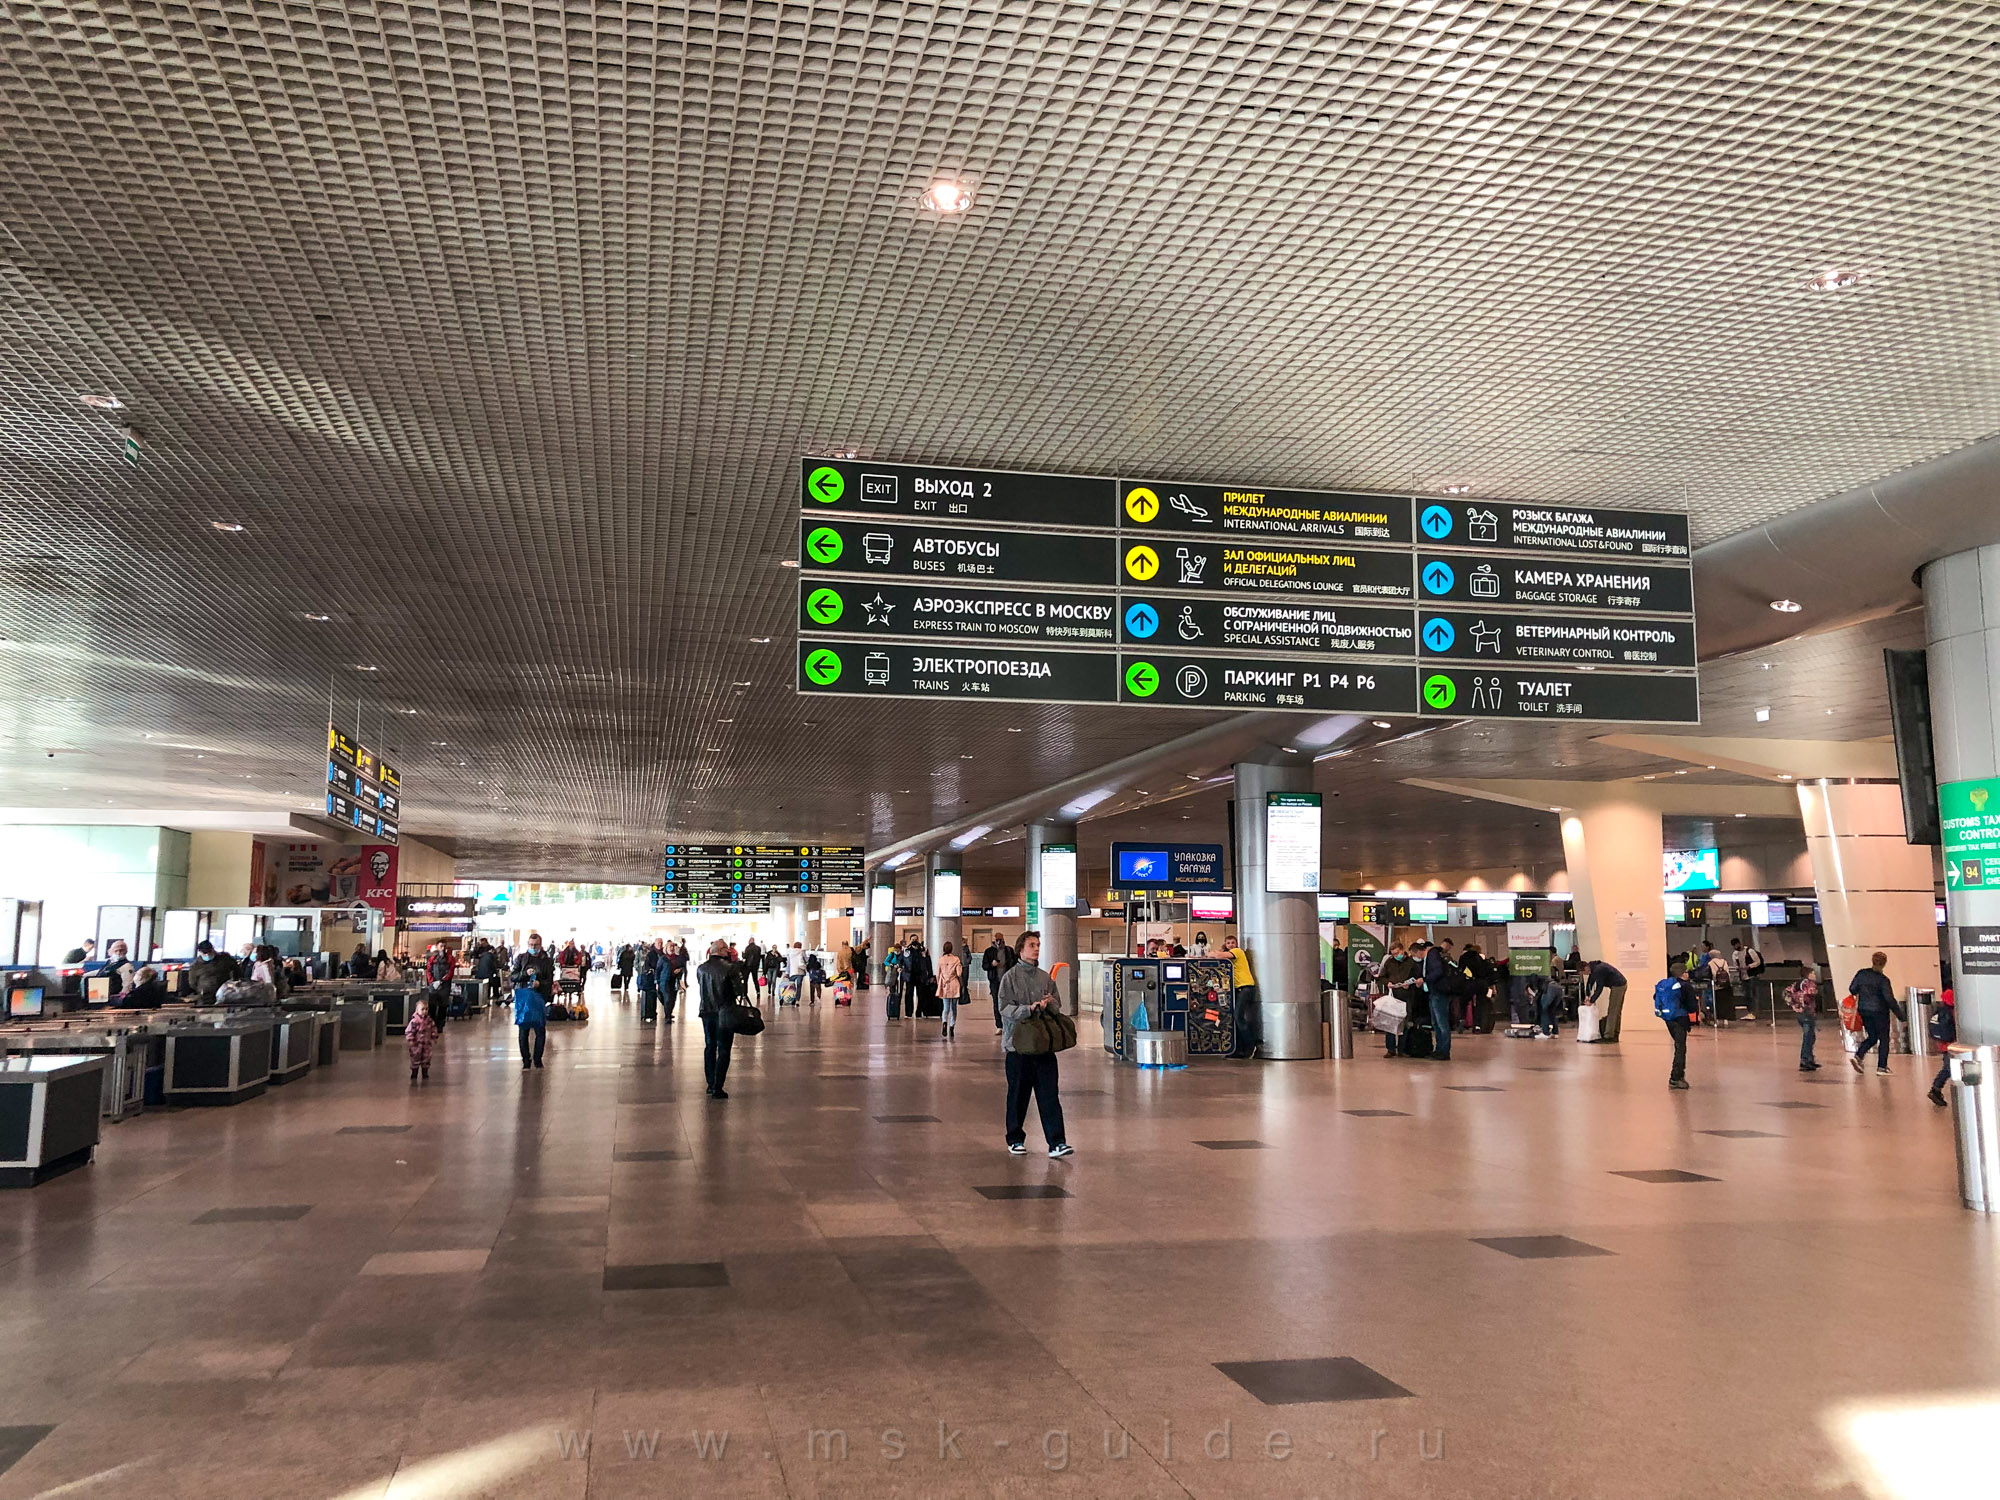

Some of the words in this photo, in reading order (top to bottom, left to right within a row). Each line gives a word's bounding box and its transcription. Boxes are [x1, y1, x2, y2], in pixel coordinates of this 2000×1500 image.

[867, 483, 891, 493] EXIT
[915, 478, 974, 498] ВЫХОД
[983, 483, 991, 497] 2
[1224, 492, 1265, 506] ПРИЛЕТ
[915, 501, 937, 510] EXIT
[949, 503, 967, 513] 出口
[1224, 505, 1320, 522] МЕЖДУНАРОДНЫЕ
[1322, 511, 1387, 525] АВИАЛИНИИ
[1513, 509, 1553, 523] РОЗЫСК
[1555, 512, 1594, 524] БАГАЖА
[1224, 519, 1299, 531] INTERNATIONAL
[1300, 523, 1344, 534] ARRIVALS
[1355, 526, 1390, 537] 国际到达
[1513, 522, 1603, 538] МЕЖДУНАРОДНЫЕ
[1606, 528, 1665, 540] АВИАЛИНИИ
[913, 538, 999, 557] АВТОБУСЫ
[1514, 535, 1577, 547] INTERNATIONAL
[1579, 538, 1633, 550] LOST&FOUND
[1224, 550, 1244, 560] ЗАЛ
[1247, 551, 1330, 567] ОФИЦИАЛЬНЫХ
[1332, 556, 1355, 567] ЛИЦ
[914, 560, 945, 571] BUSES
[957, 563, 994, 573] 机场巴士
[1224, 564, 1232, 574] И
[1234, 561, 1296, 576] ДЕЛЕГАЦИЙ
[1224, 578, 1258, 587] OFFICIAL
[1260, 579, 1311, 589] DELEGATIONS
[1313, 582, 1343, 591] LOUNGE
[1515, 570, 1573, 586] КАМЕРА
[1576, 574, 1650, 590] ХРАНЕНИЯ
[1516, 591, 1555, 601] BAGGAGE
[1559, 593, 1597, 603] STORAGE
[914, 598, 1031, 616] АЭРОЭКСПРЕСС
[1036, 604, 1045, 617] В
[1050, 604, 1112, 620] МОСКВУ
[1224, 607, 1311, 621] ОБСЛУЖИВАНИЕ
[1312, 611, 1336, 624] ЛИЦ
[914, 620, 953, 630] EXPRESS
[955, 622, 981, 631] TRAIN
[985, 623, 996, 632] TO
[999, 624, 1039, 634] MOSCOW
[1224, 620, 1231, 630] С
[1233, 618, 1320, 636] ОГРАНИЧЕННОЙ
[1322, 625, 1412, 640] ПОДВИЖНОСТЬЮ
[1224, 634, 1262, 644] SPECIAL
[1264, 636, 1320, 646] ASSISTANCE
[1516, 626, 1610, 640] ВЕТЕРИНАРНЫЙ
[1613, 629, 1675, 643] КОНТРОЛЬ
[1516, 647, 1570, 656] VETERINARY
[1573, 649, 1614, 658] CONTROL
[913, 658, 1051, 678] ЭЛЕКТРОПОЕЗДА
[913, 680, 949, 690] TRAINS
[962, 682, 989, 692] 火车站
[1225, 670, 1295, 686] ПАРКИНГ
[1304, 673, 1321, 687] P1
[1330, 674, 1349, 688] P4
[1357, 675, 1375, 689] P6
[1517, 682, 1572, 696] ТУАЛЕТ
[1225, 692, 1265, 702] PARKING
[1277, 695, 1303, 704] 停车场
[1518, 702, 1549, 711] TOILET
[1557, 704, 1582, 713] 洗手间
[1943, 816, 1981, 830] CUSTOMS
[1174, 852, 1217, 862] УПАКОВКА
[1179, 863, 1211, 873] БАГАЖА
[1965, 866, 1979, 878] 94
[366, 889, 393, 898] KFC
[1392, 906, 1406, 918] 14
[1520, 907, 1533, 919] 15
[1568, 908, 1574, 919] 1
[1690, 907, 1702, 919] 17
[1735, 908, 1748, 920] 18
